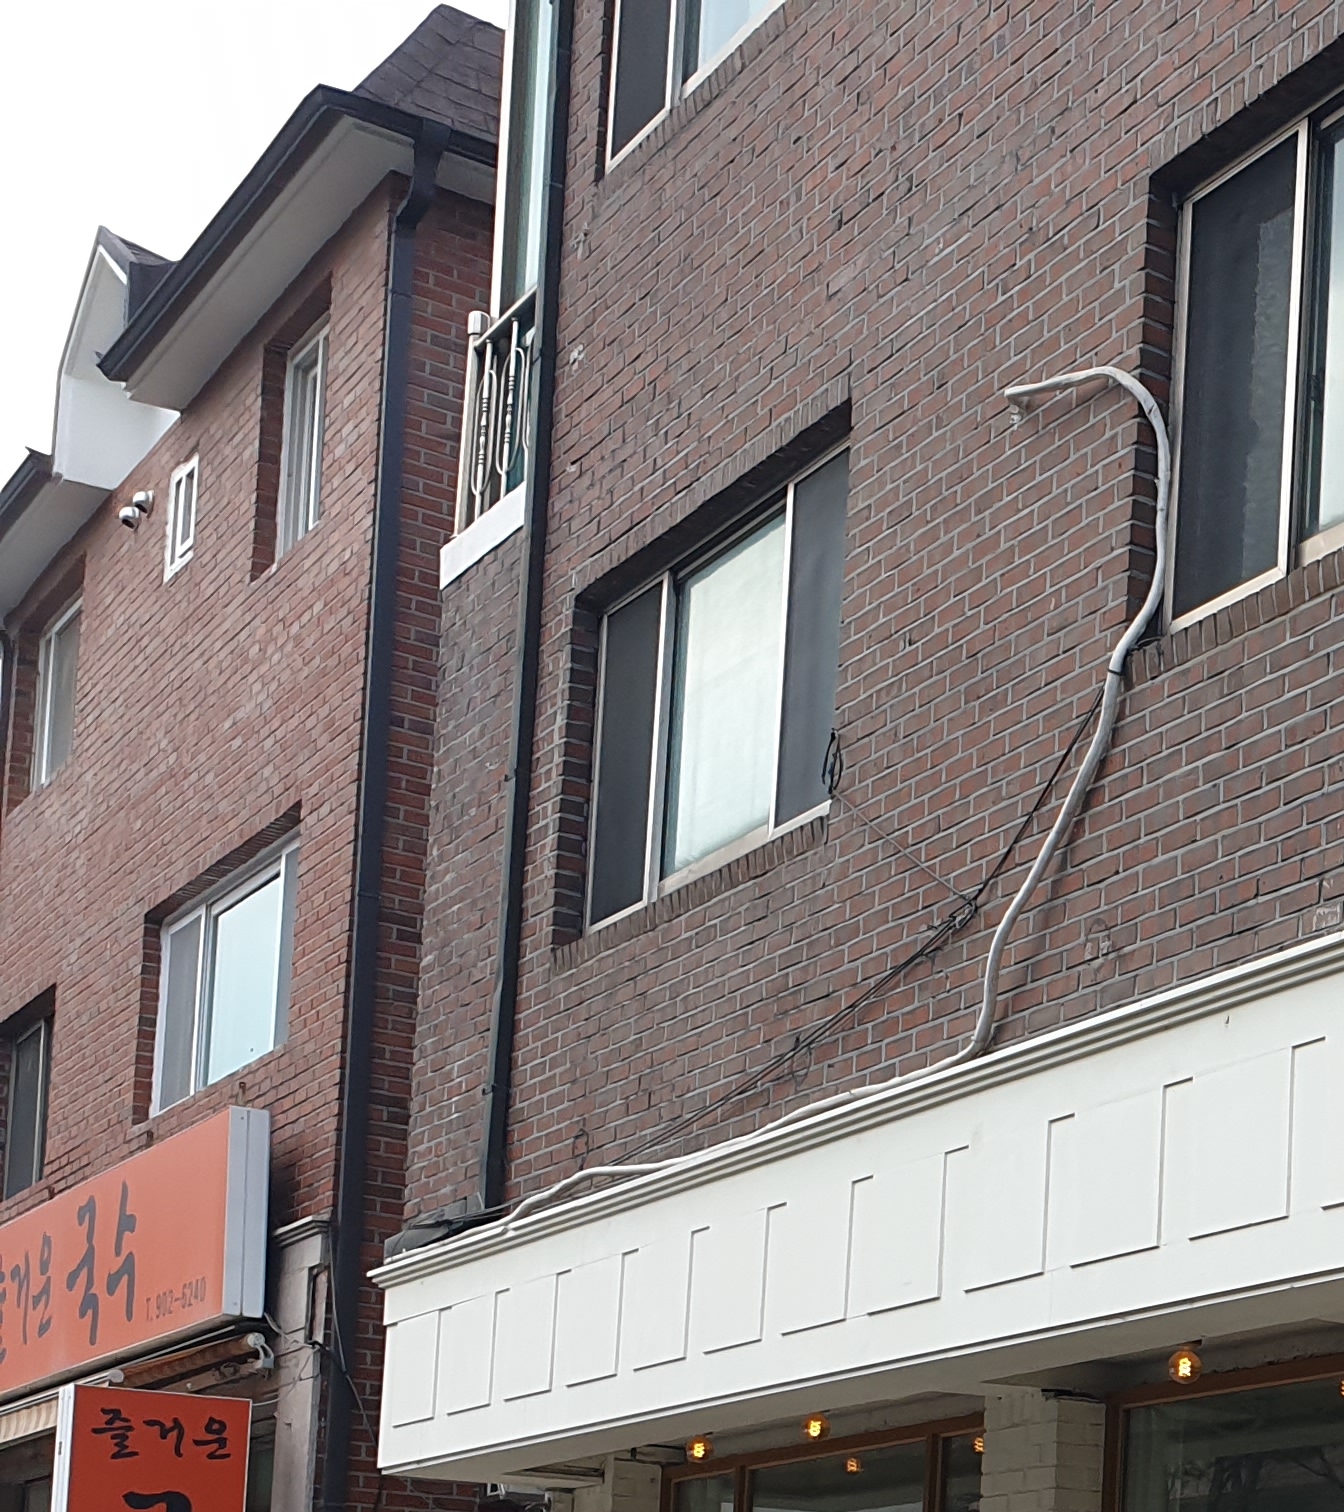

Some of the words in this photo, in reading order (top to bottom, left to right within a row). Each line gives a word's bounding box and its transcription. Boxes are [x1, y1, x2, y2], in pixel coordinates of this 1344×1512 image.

[0, 1231, 52, 1365] 거운
[66, 1180, 137, 1346] 국수
[146, 1277, 207, 1321] T.902-6240
[91, 1407, 231, 1460] 즐거운
